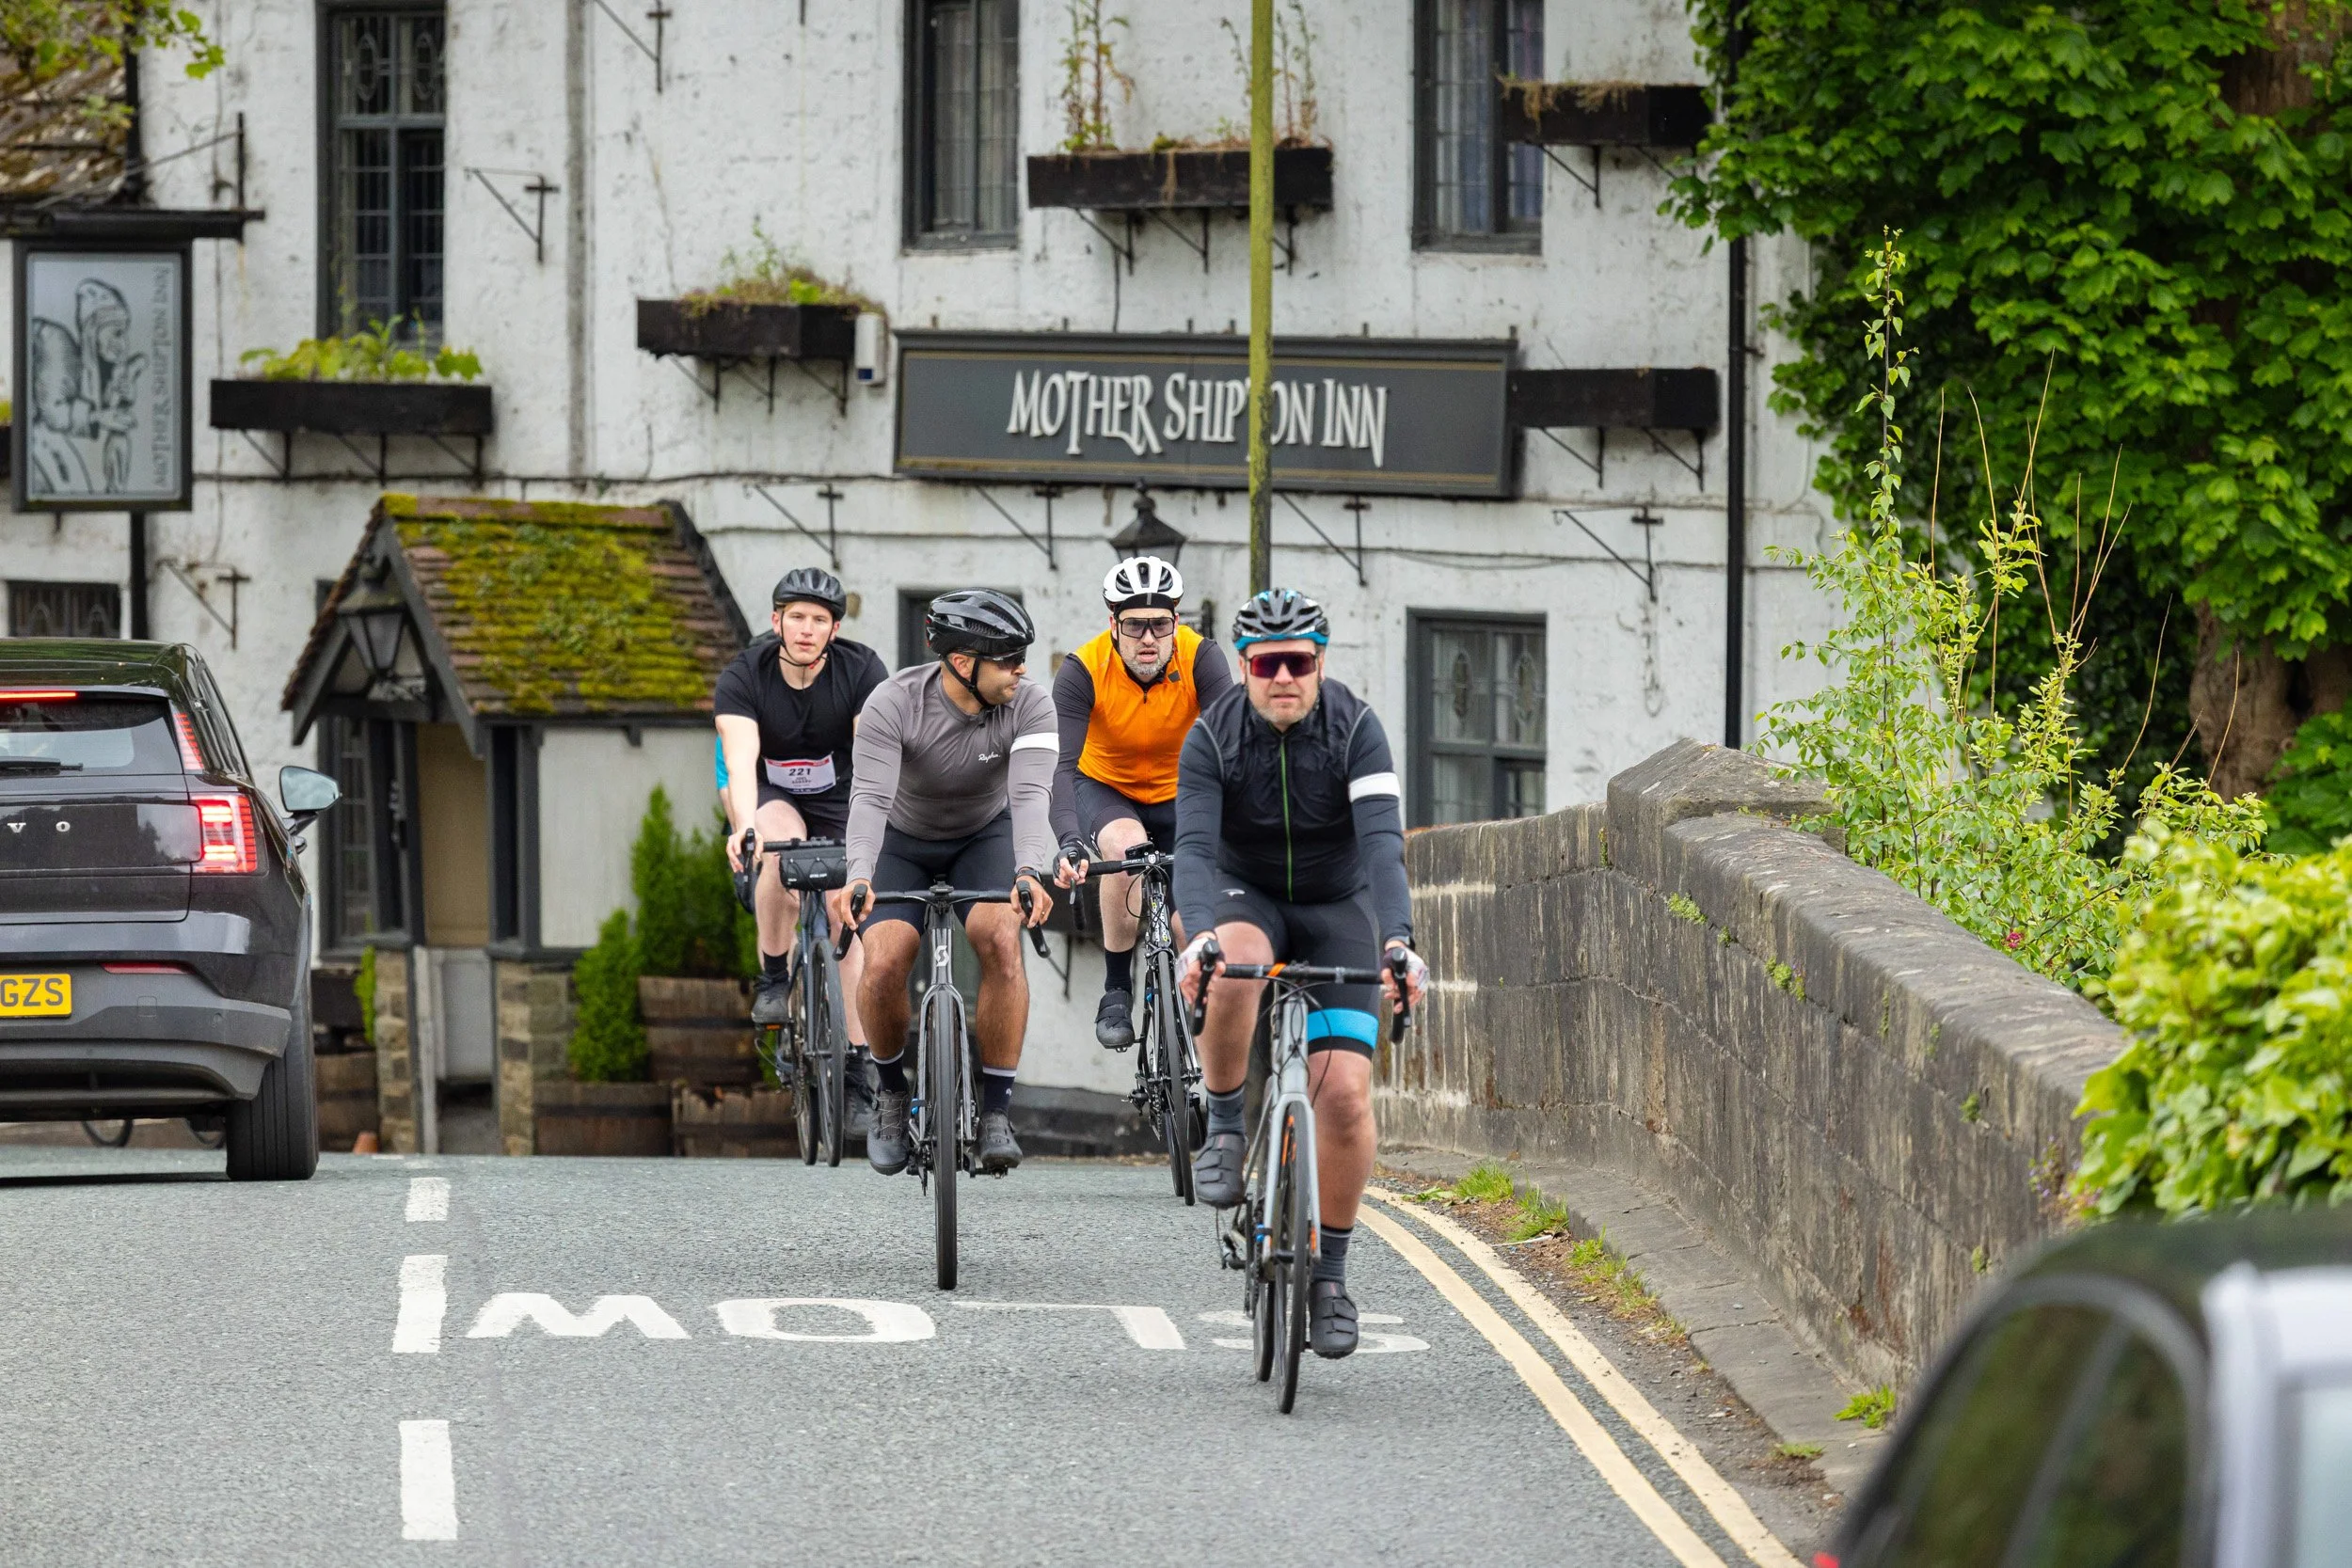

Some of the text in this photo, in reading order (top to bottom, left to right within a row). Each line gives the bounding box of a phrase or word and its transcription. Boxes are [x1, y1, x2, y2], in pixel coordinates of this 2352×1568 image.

[1006, 370, 1387, 467] MOTHER SHIPON INN
[788, 768, 811, 777] 221
[0, 978, 64, 1007] GZS
